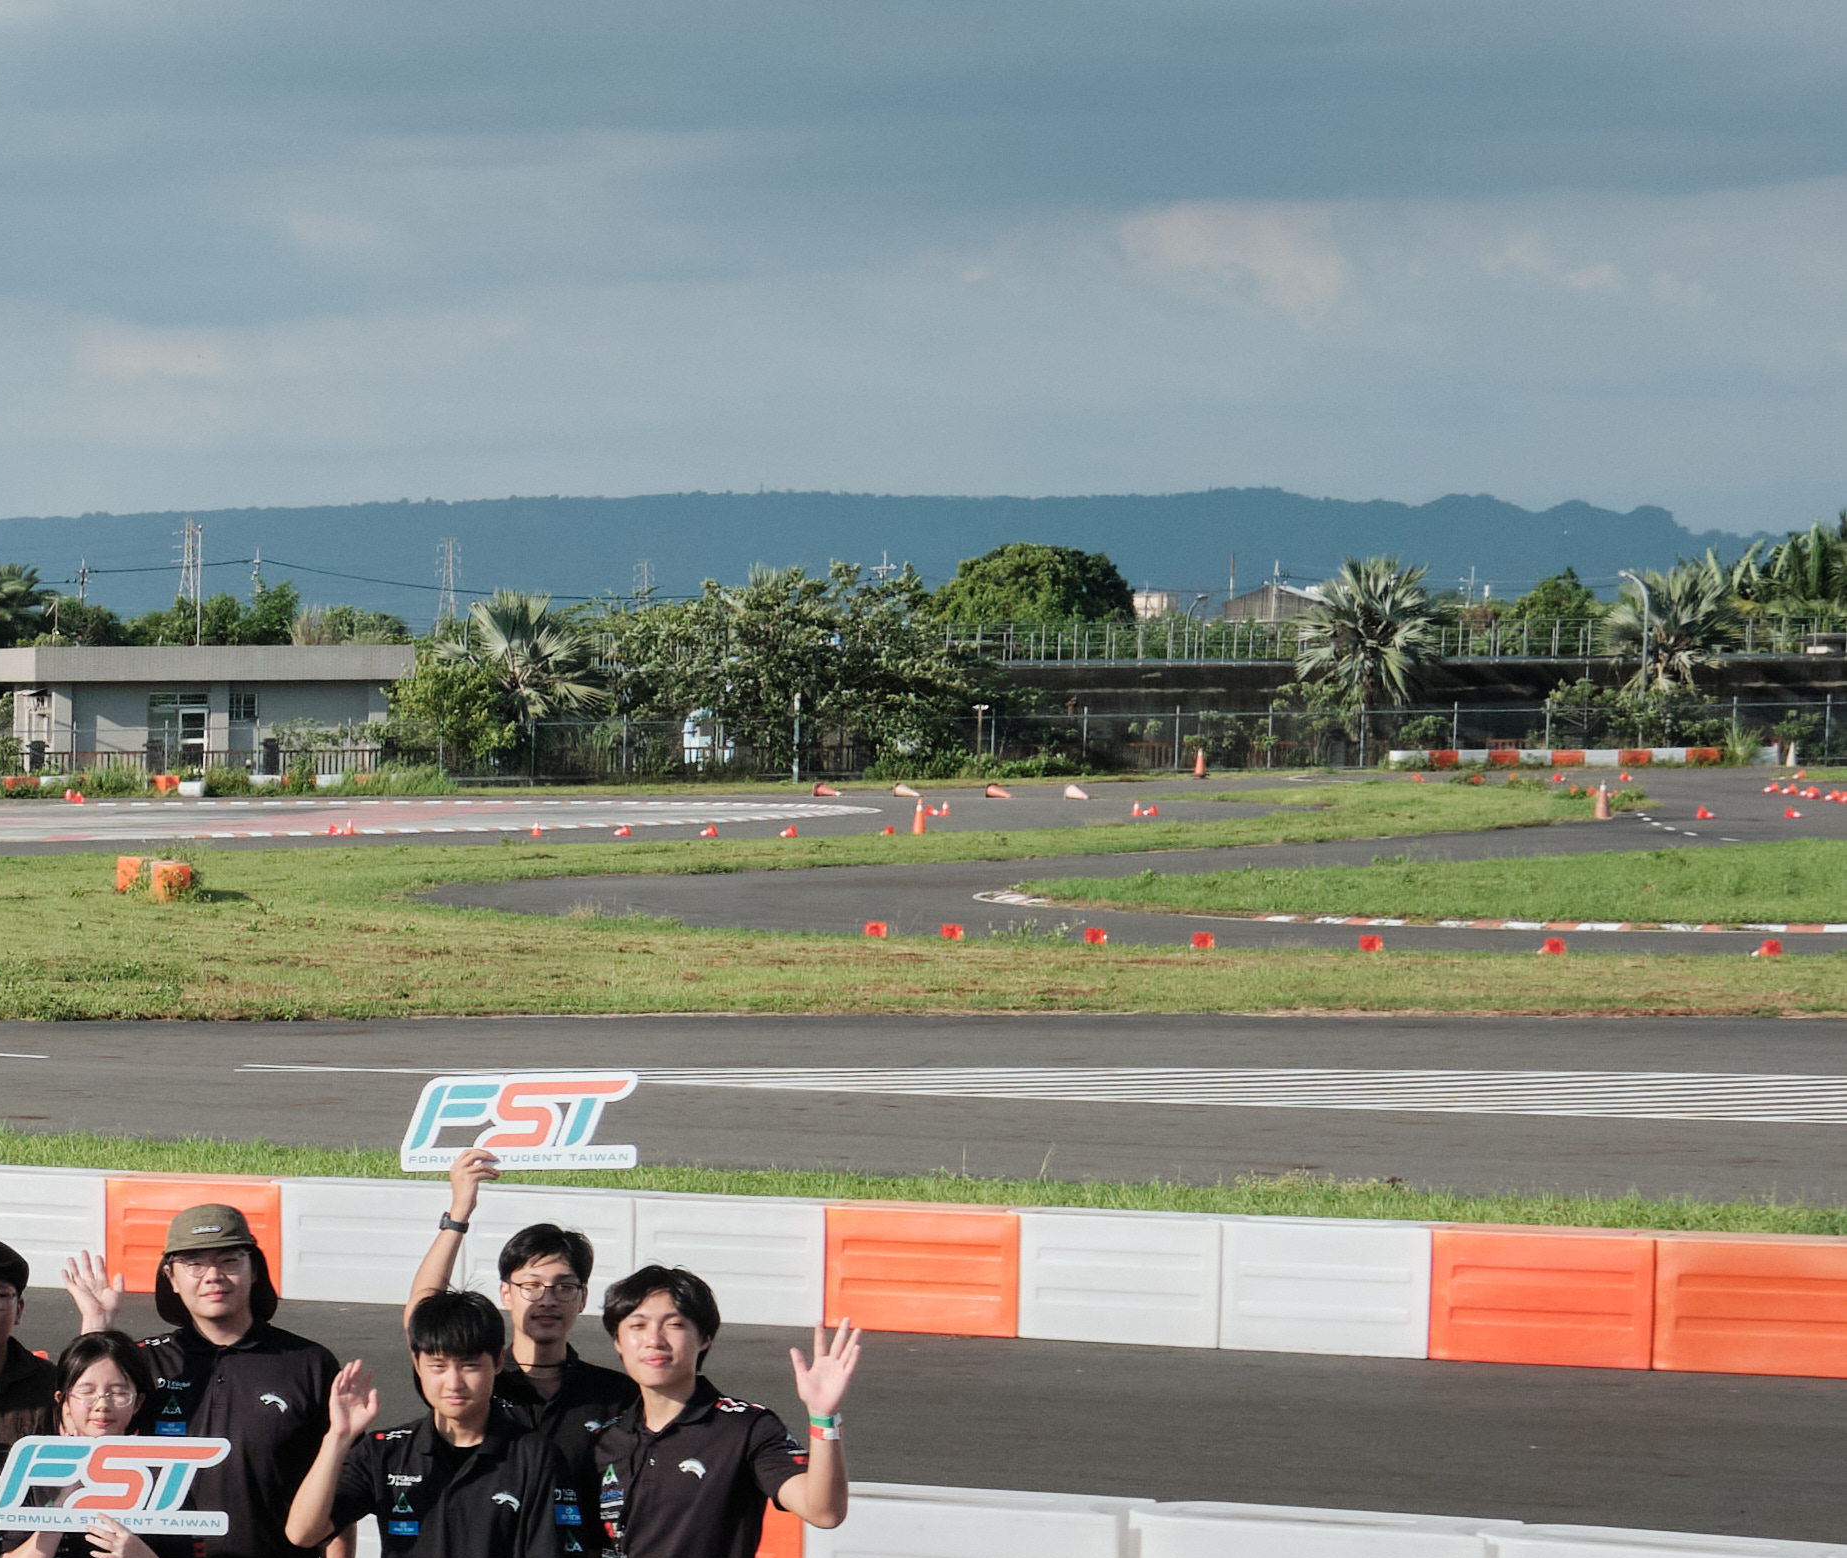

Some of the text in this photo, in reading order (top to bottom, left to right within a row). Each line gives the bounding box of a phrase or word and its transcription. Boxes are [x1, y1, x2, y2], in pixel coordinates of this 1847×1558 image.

[410, 1080, 629, 1150] FST
[409, 1153, 628, 1164] FORM TUDENT TAIWAN
[160, 1518, 221, 1527] TAIWAN
